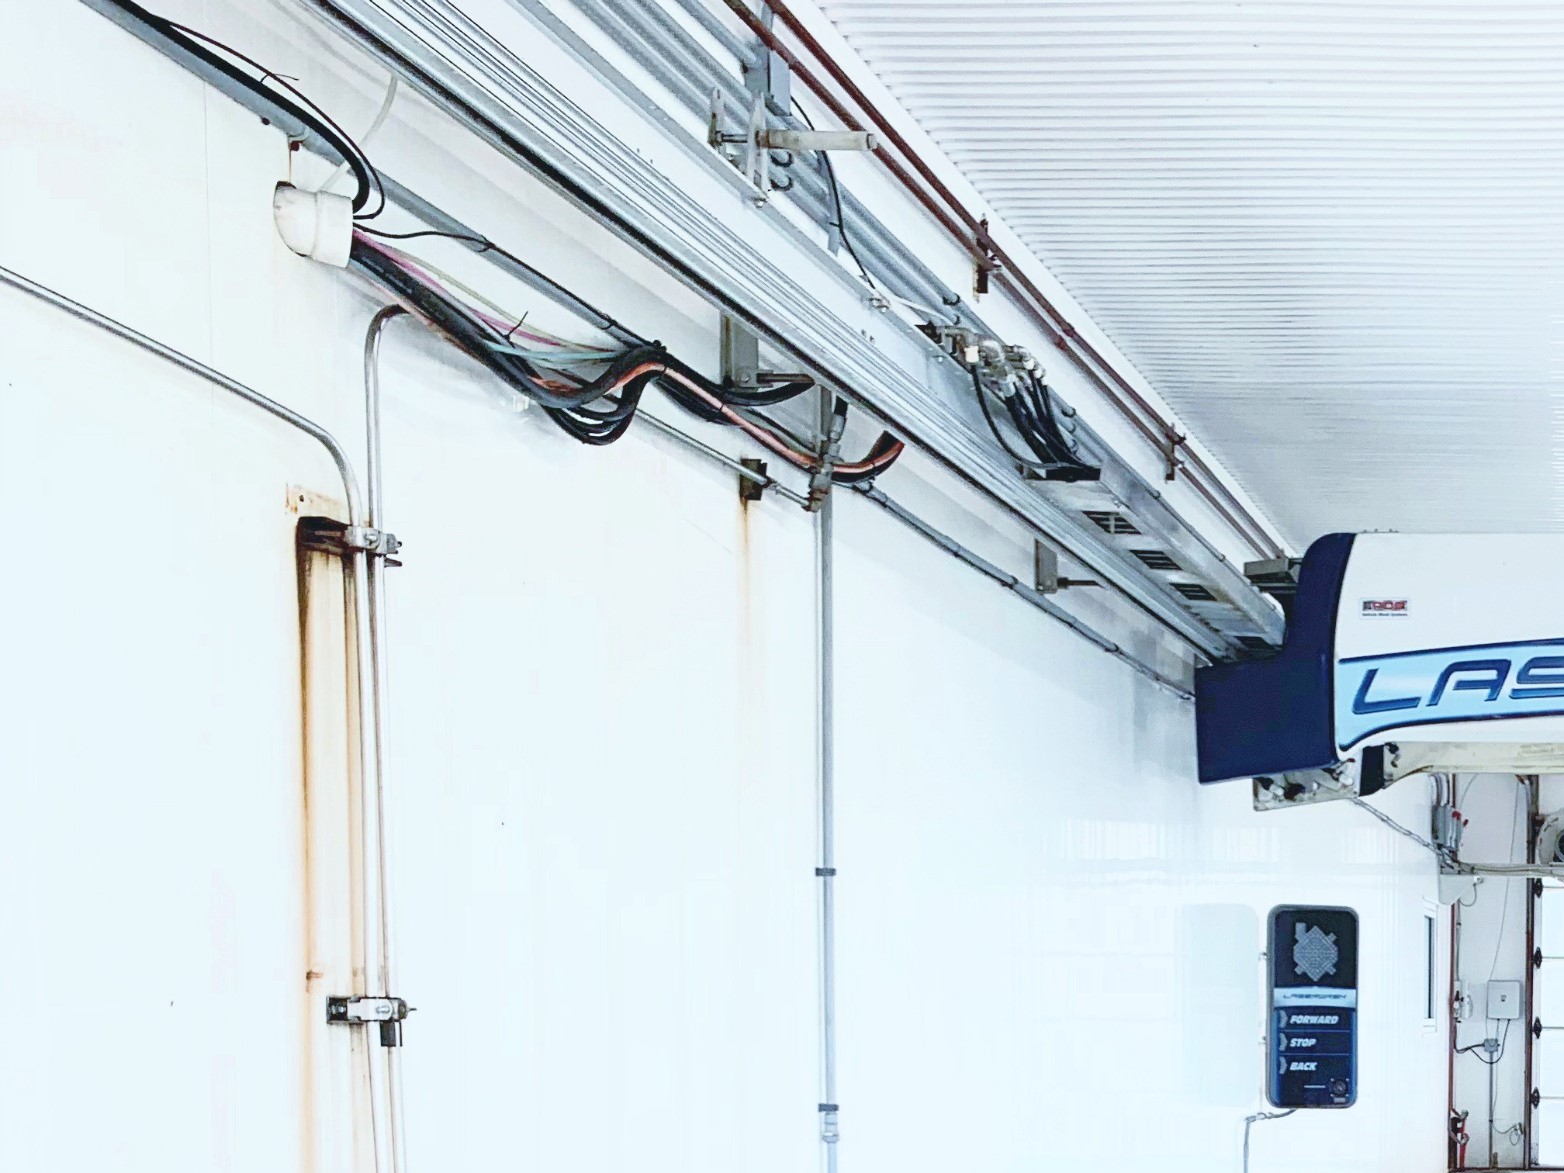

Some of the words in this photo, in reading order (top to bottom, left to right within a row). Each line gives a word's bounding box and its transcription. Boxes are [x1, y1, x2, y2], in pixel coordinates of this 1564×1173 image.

[1290, 1015, 1339, 1025] FORWARD
[1290, 1038, 1317, 1047] STOP
[1290, 1062, 1317, 1071] BACK
